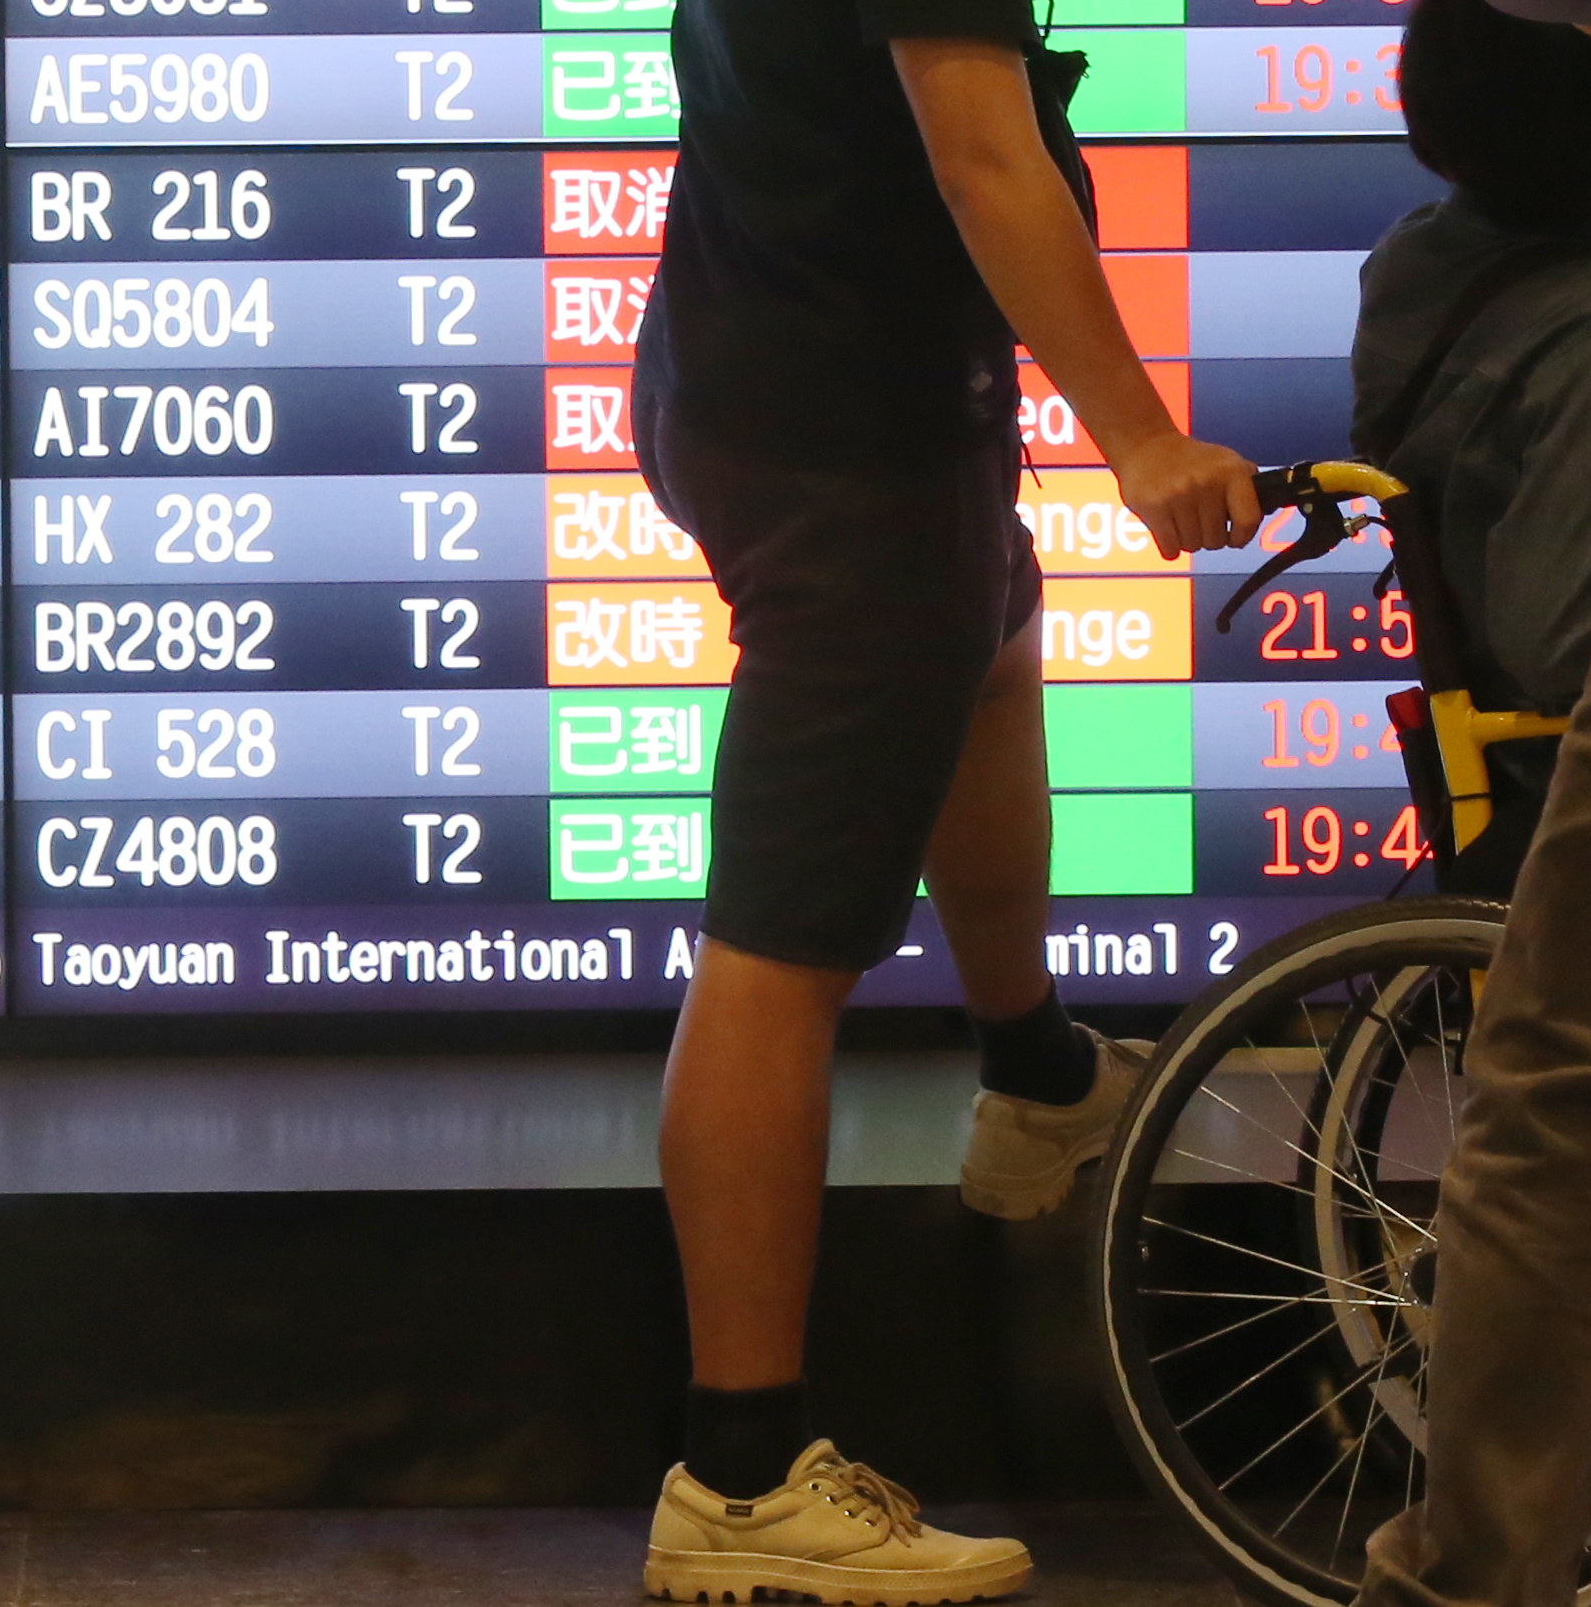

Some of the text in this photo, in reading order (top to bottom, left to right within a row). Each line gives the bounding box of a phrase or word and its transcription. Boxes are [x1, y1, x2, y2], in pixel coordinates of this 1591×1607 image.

[31, 169, 271, 242] BR 216
[396, 167, 477, 238] T2
[33, 276, 276, 350] SQ5804
[34, 384, 274, 457] AI7060
[398, 382, 478, 454] T2
[35, 600, 275, 673] BR2892
[400, 598, 480, 669] T2
[552, 594, 706, 670] 改時
[36, 707, 277, 780] CI 528
[37, 815, 277, 888] CZ4808
[402, 813, 483, 884] T2
[558, 810, 704, 885] 已到
[31, 932, 235, 991] Taoyuan
[264, 927, 633, 985] International
[1046, 922, 1178, 977] minal
[1208, 921, 1239, 975] 2
